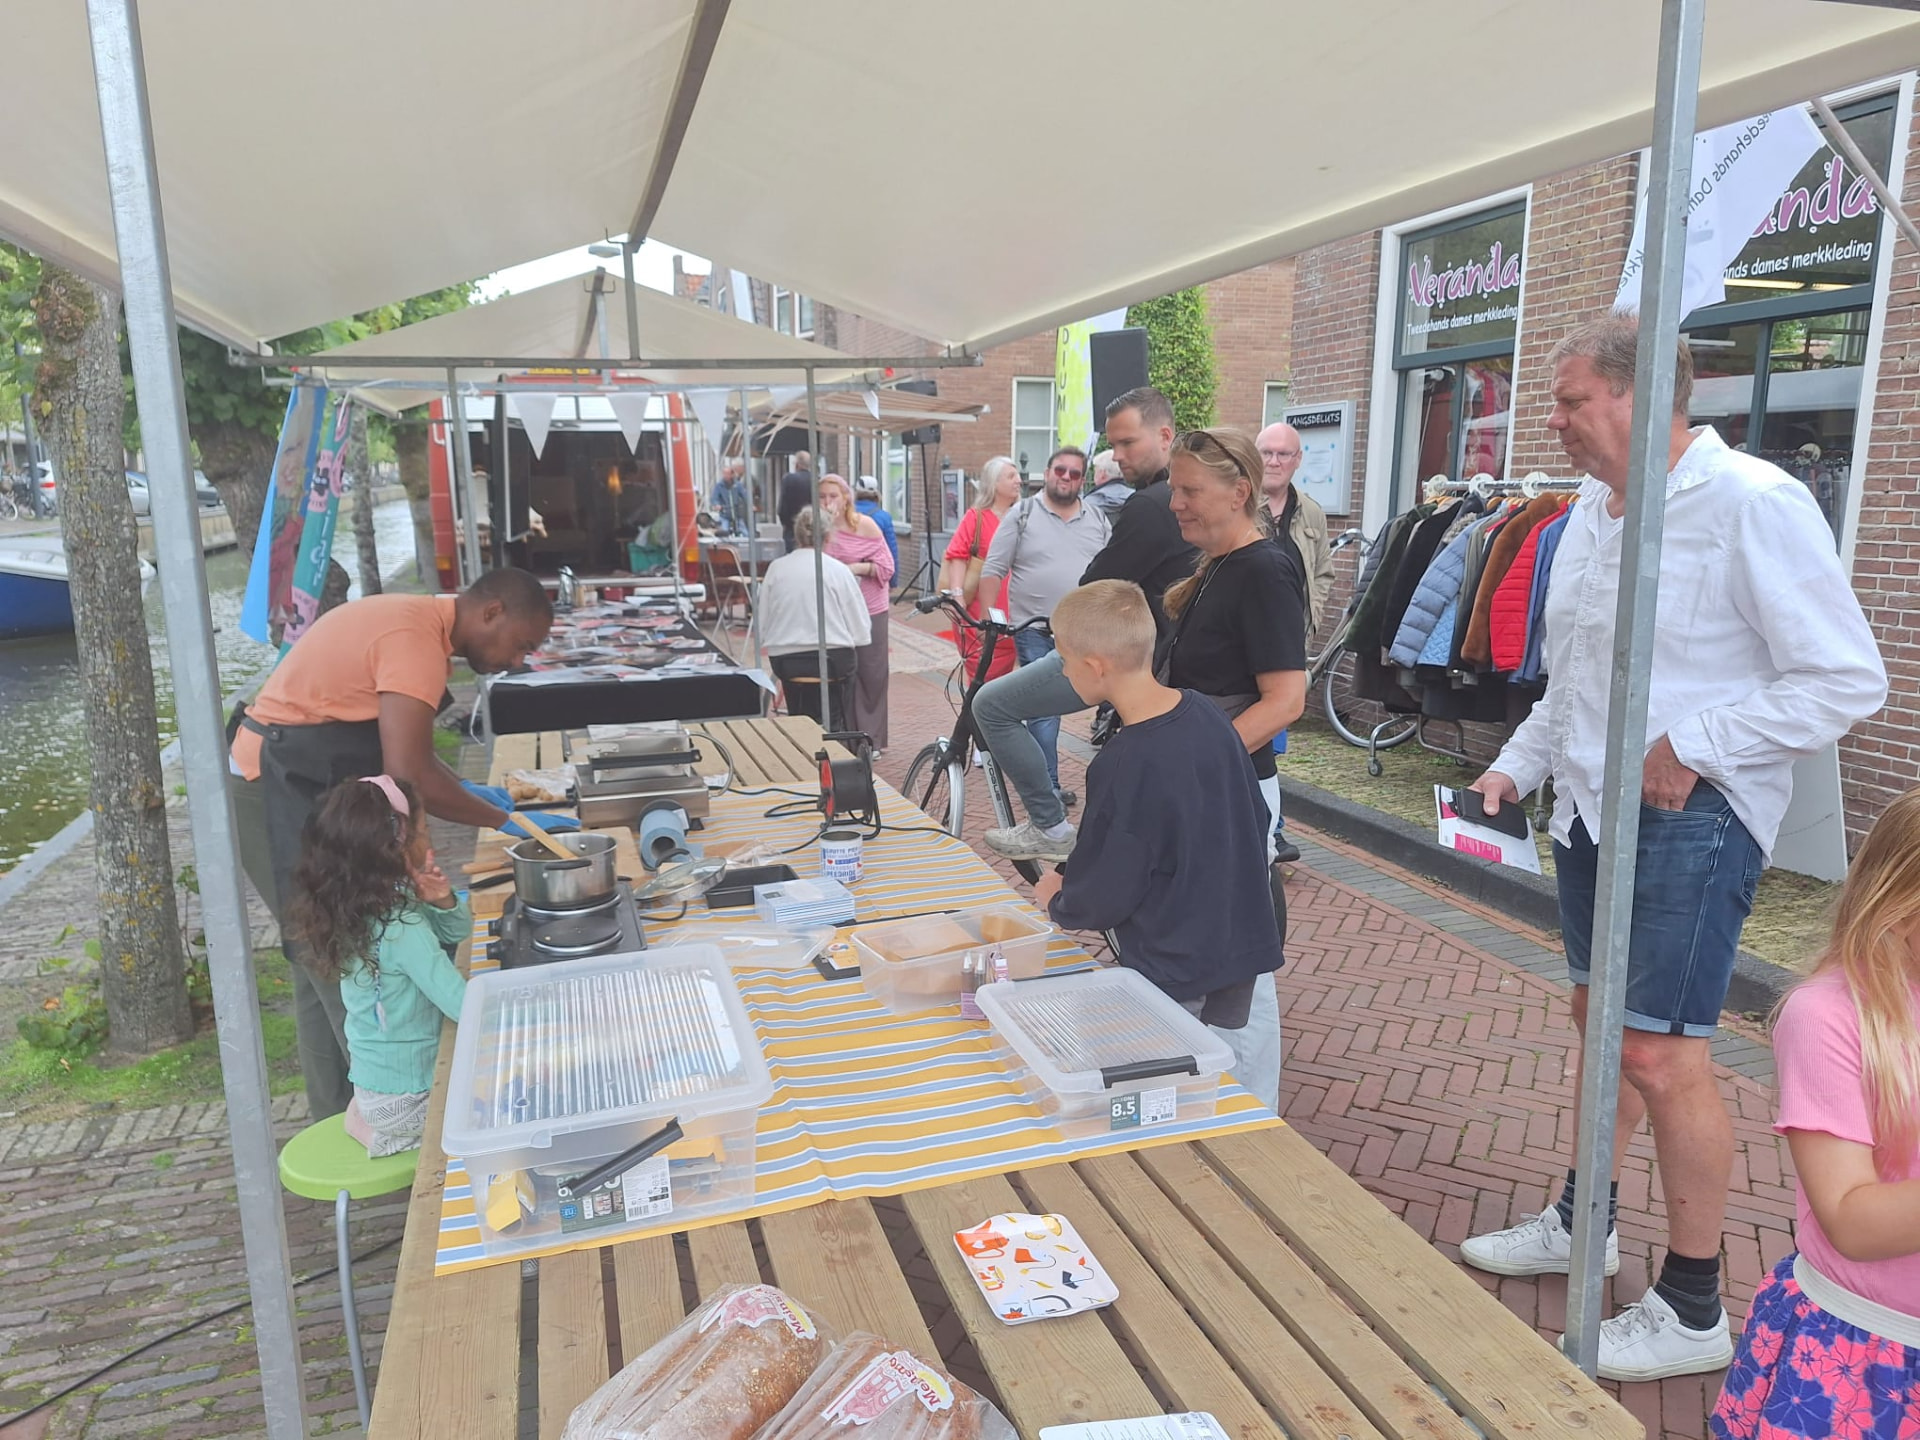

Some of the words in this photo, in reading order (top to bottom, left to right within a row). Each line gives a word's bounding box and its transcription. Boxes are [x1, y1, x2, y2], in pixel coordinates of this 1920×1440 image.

[1409, 241, 1520, 307] Veranda
[1751, 257, 1789, 276] dames
[1792, 240, 1872, 268] merkkleding
[1407, 318, 1449, 335] Tweedehands
[1450, 314, 1472, 328] dames
[1474, 305, 1517, 321] merkkleding
[1112, 1101, 1135, 1117] 8.5
